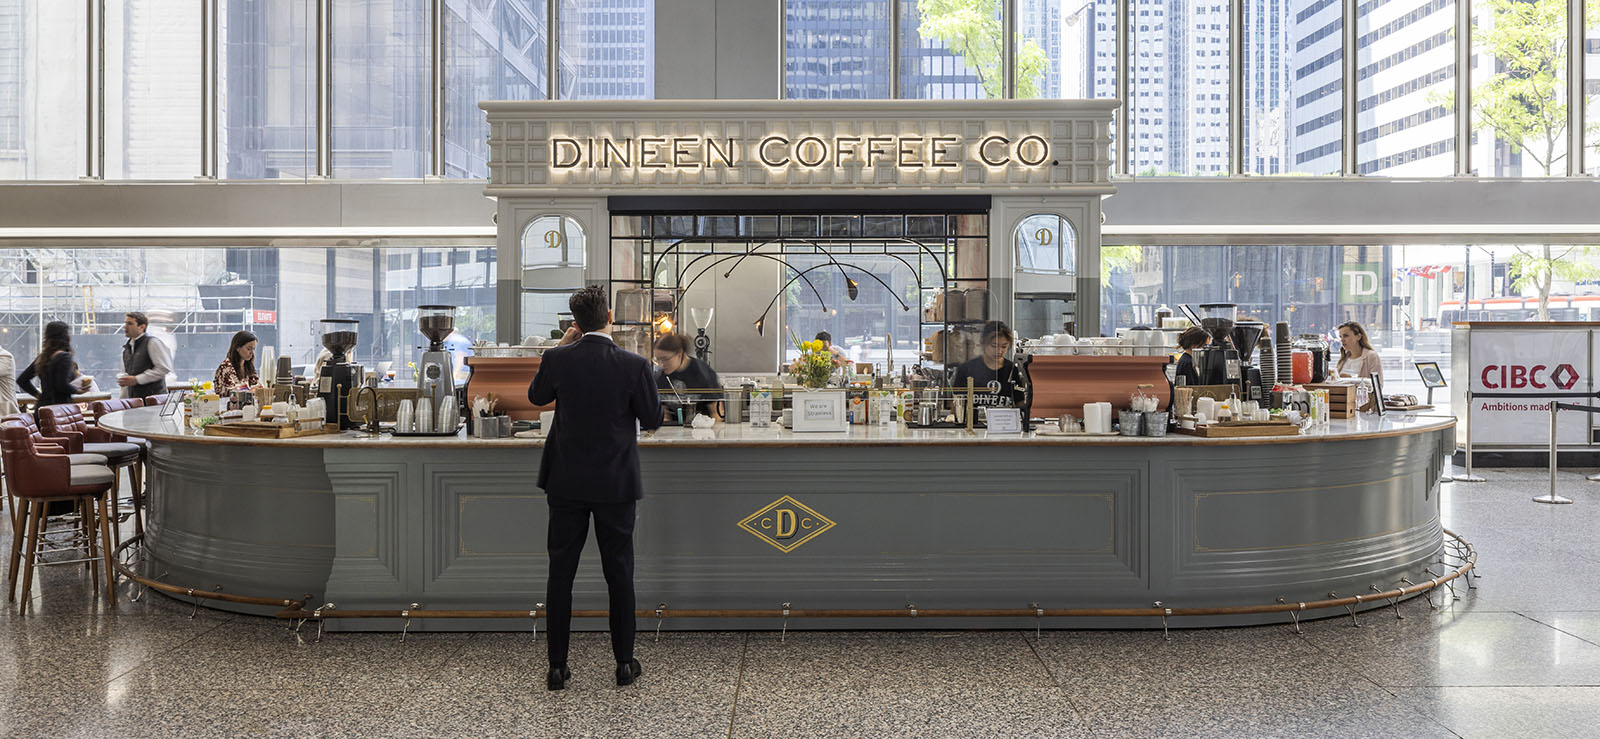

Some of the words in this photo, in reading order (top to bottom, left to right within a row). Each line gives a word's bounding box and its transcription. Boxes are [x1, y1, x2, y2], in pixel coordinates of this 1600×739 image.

[552, 138, 734, 168] DINEEN
[759, 136, 957, 168] COFFEE
[980, 135, 1059, 167] CO.
[544, 230, 561, 248] D
[1035, 228, 1052, 246] D
[1342, 270, 1377, 296] TD
[1481, 365, 1547, 389] CIBC
[1481, 402, 1528, 412] Ambitions
[1530, 402, 1554, 412] mad
